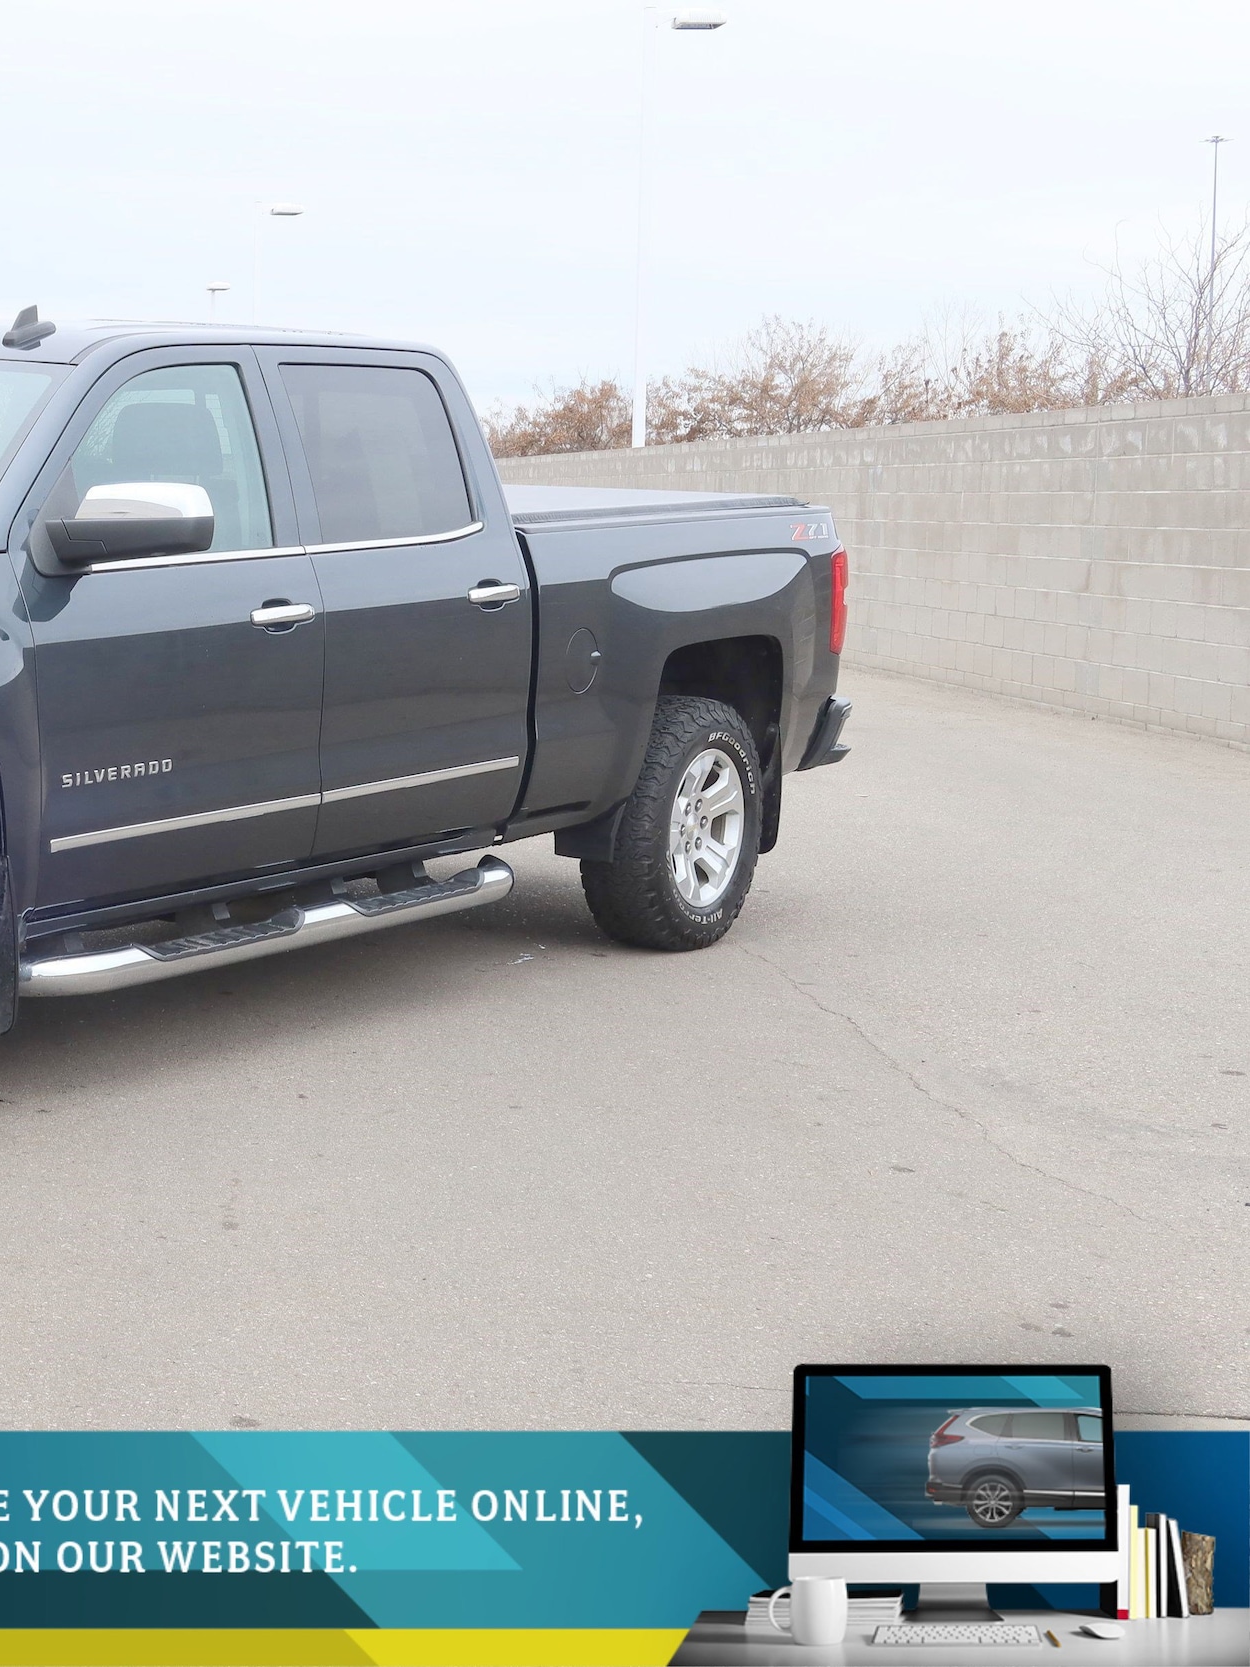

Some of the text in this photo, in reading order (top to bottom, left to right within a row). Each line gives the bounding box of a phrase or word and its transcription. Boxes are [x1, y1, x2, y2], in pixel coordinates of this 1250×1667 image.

[790, 523, 829, 541] Z71
[61, 759, 173, 788] SILVERADO
[708, 732, 756, 795] BFGoodrich
